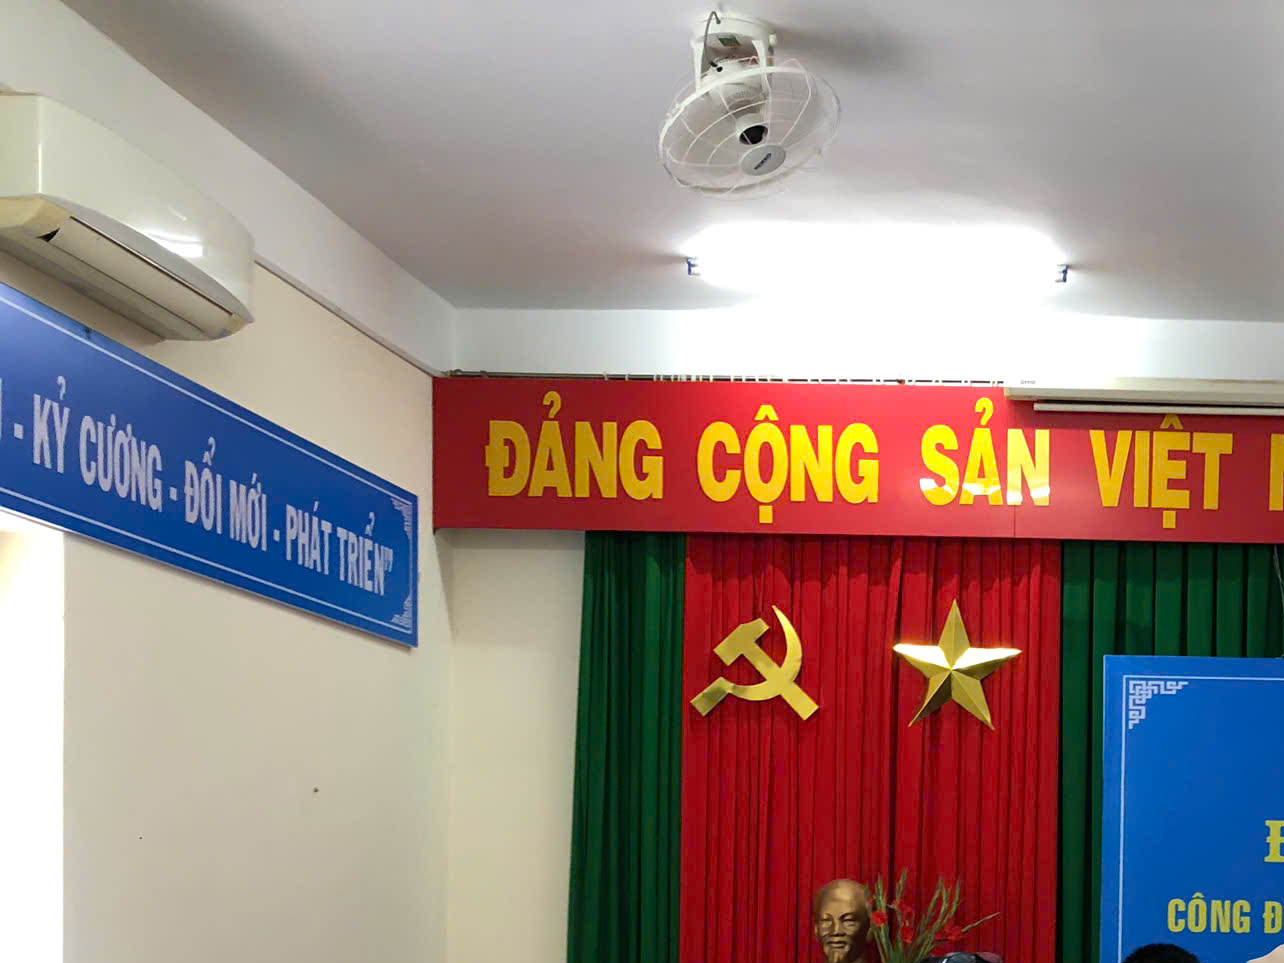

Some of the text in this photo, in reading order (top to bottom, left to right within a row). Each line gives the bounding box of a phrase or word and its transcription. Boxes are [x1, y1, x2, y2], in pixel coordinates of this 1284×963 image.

[33, 376, 70, 474] KỶ
[79, 413, 163, 512] CƯƠNG
[184, 436, 223, 534] ĐỔI
[229, 472, 268, 551] MỚI
[285, 501, 332, 575] PHÁT
[485, 391, 664, 500] ĐẢNG
[697, 404, 879, 523] CỘNG
[919, 397, 1050, 506] SẢN
[1089, 414, 1233, 529] VIỆT
[1167, 892, 1251, 935] CÔNG
